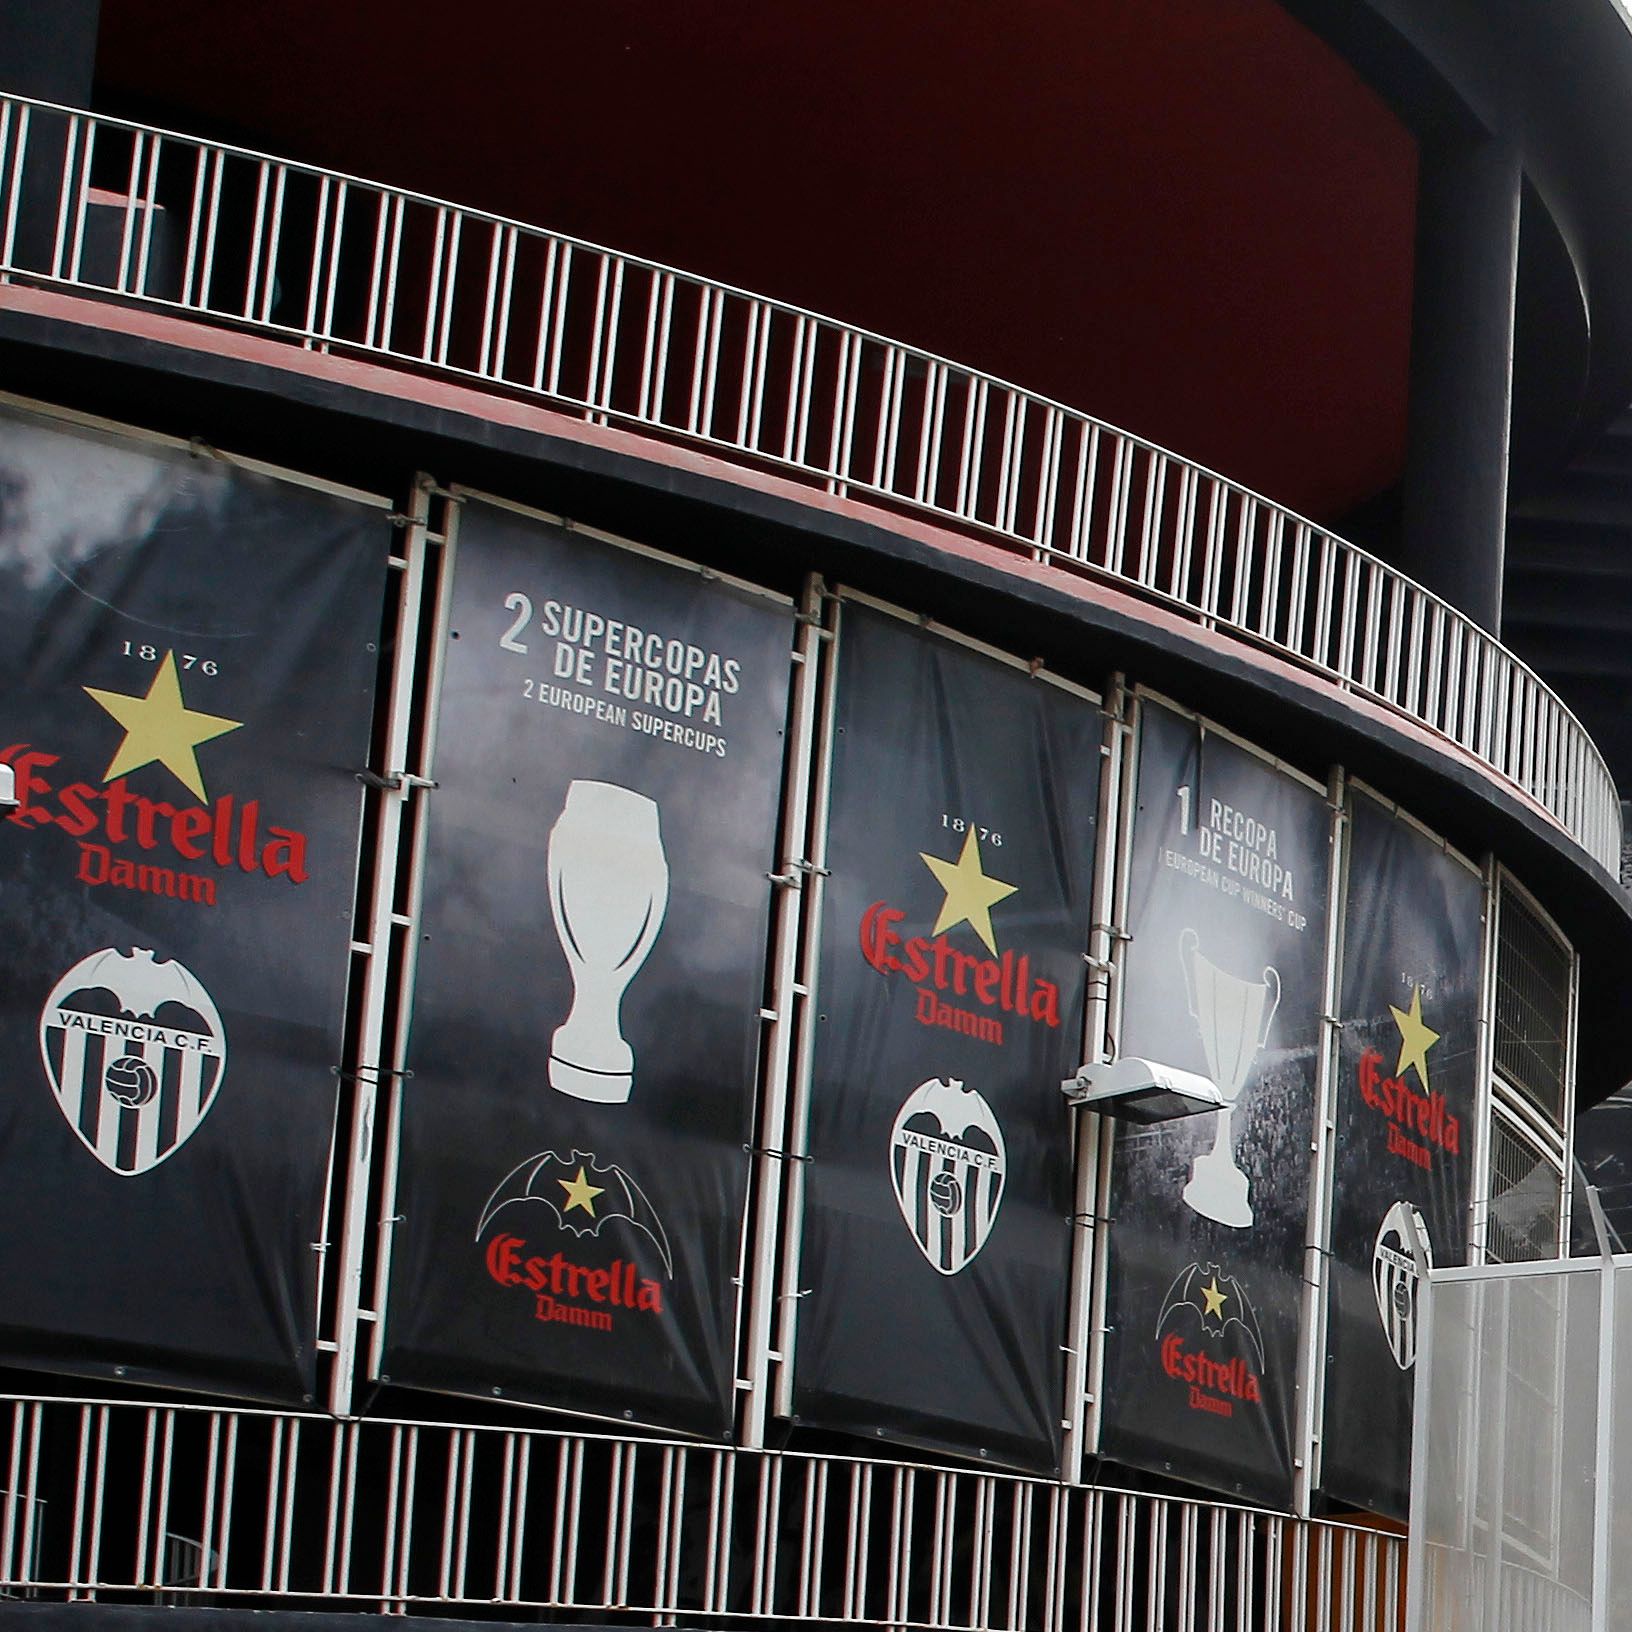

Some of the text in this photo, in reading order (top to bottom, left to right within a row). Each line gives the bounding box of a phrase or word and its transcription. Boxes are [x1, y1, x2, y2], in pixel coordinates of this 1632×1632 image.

[499, 591, 741, 694] 2 SUPERCOPAS
[523, 679, 727, 758] 2 EUROPEAN SUPERCUPS
[553, 641, 722, 728] DE EUROPA
[0, 744, 310, 884] Estrella
[1177, 785, 1277, 860] 1 RECOPA
[75, 841, 216, 906] Damm
[1165, 850, 1219, 889] EUROPEAN
[1288, 910, 1307, 932] CUP
[1200, 825, 1293, 901] DE EUROPA
[859, 900, 1061, 1028] Estrella
[58, 1012, 213, 1053] VALENCIA C.F.
[914, 986, 1004, 1047] Damm
[1358, 1045, 1460, 1156] Estrella
[902, 1132, 998, 1171] VALENCIA C.F.
[1386, 1120, 1432, 1172] Damm
[485, 1232, 664, 1315] Estrella
[534, 1292, 613, 1333] Damm
[1161, 1332, 1262, 1404] Estrella
